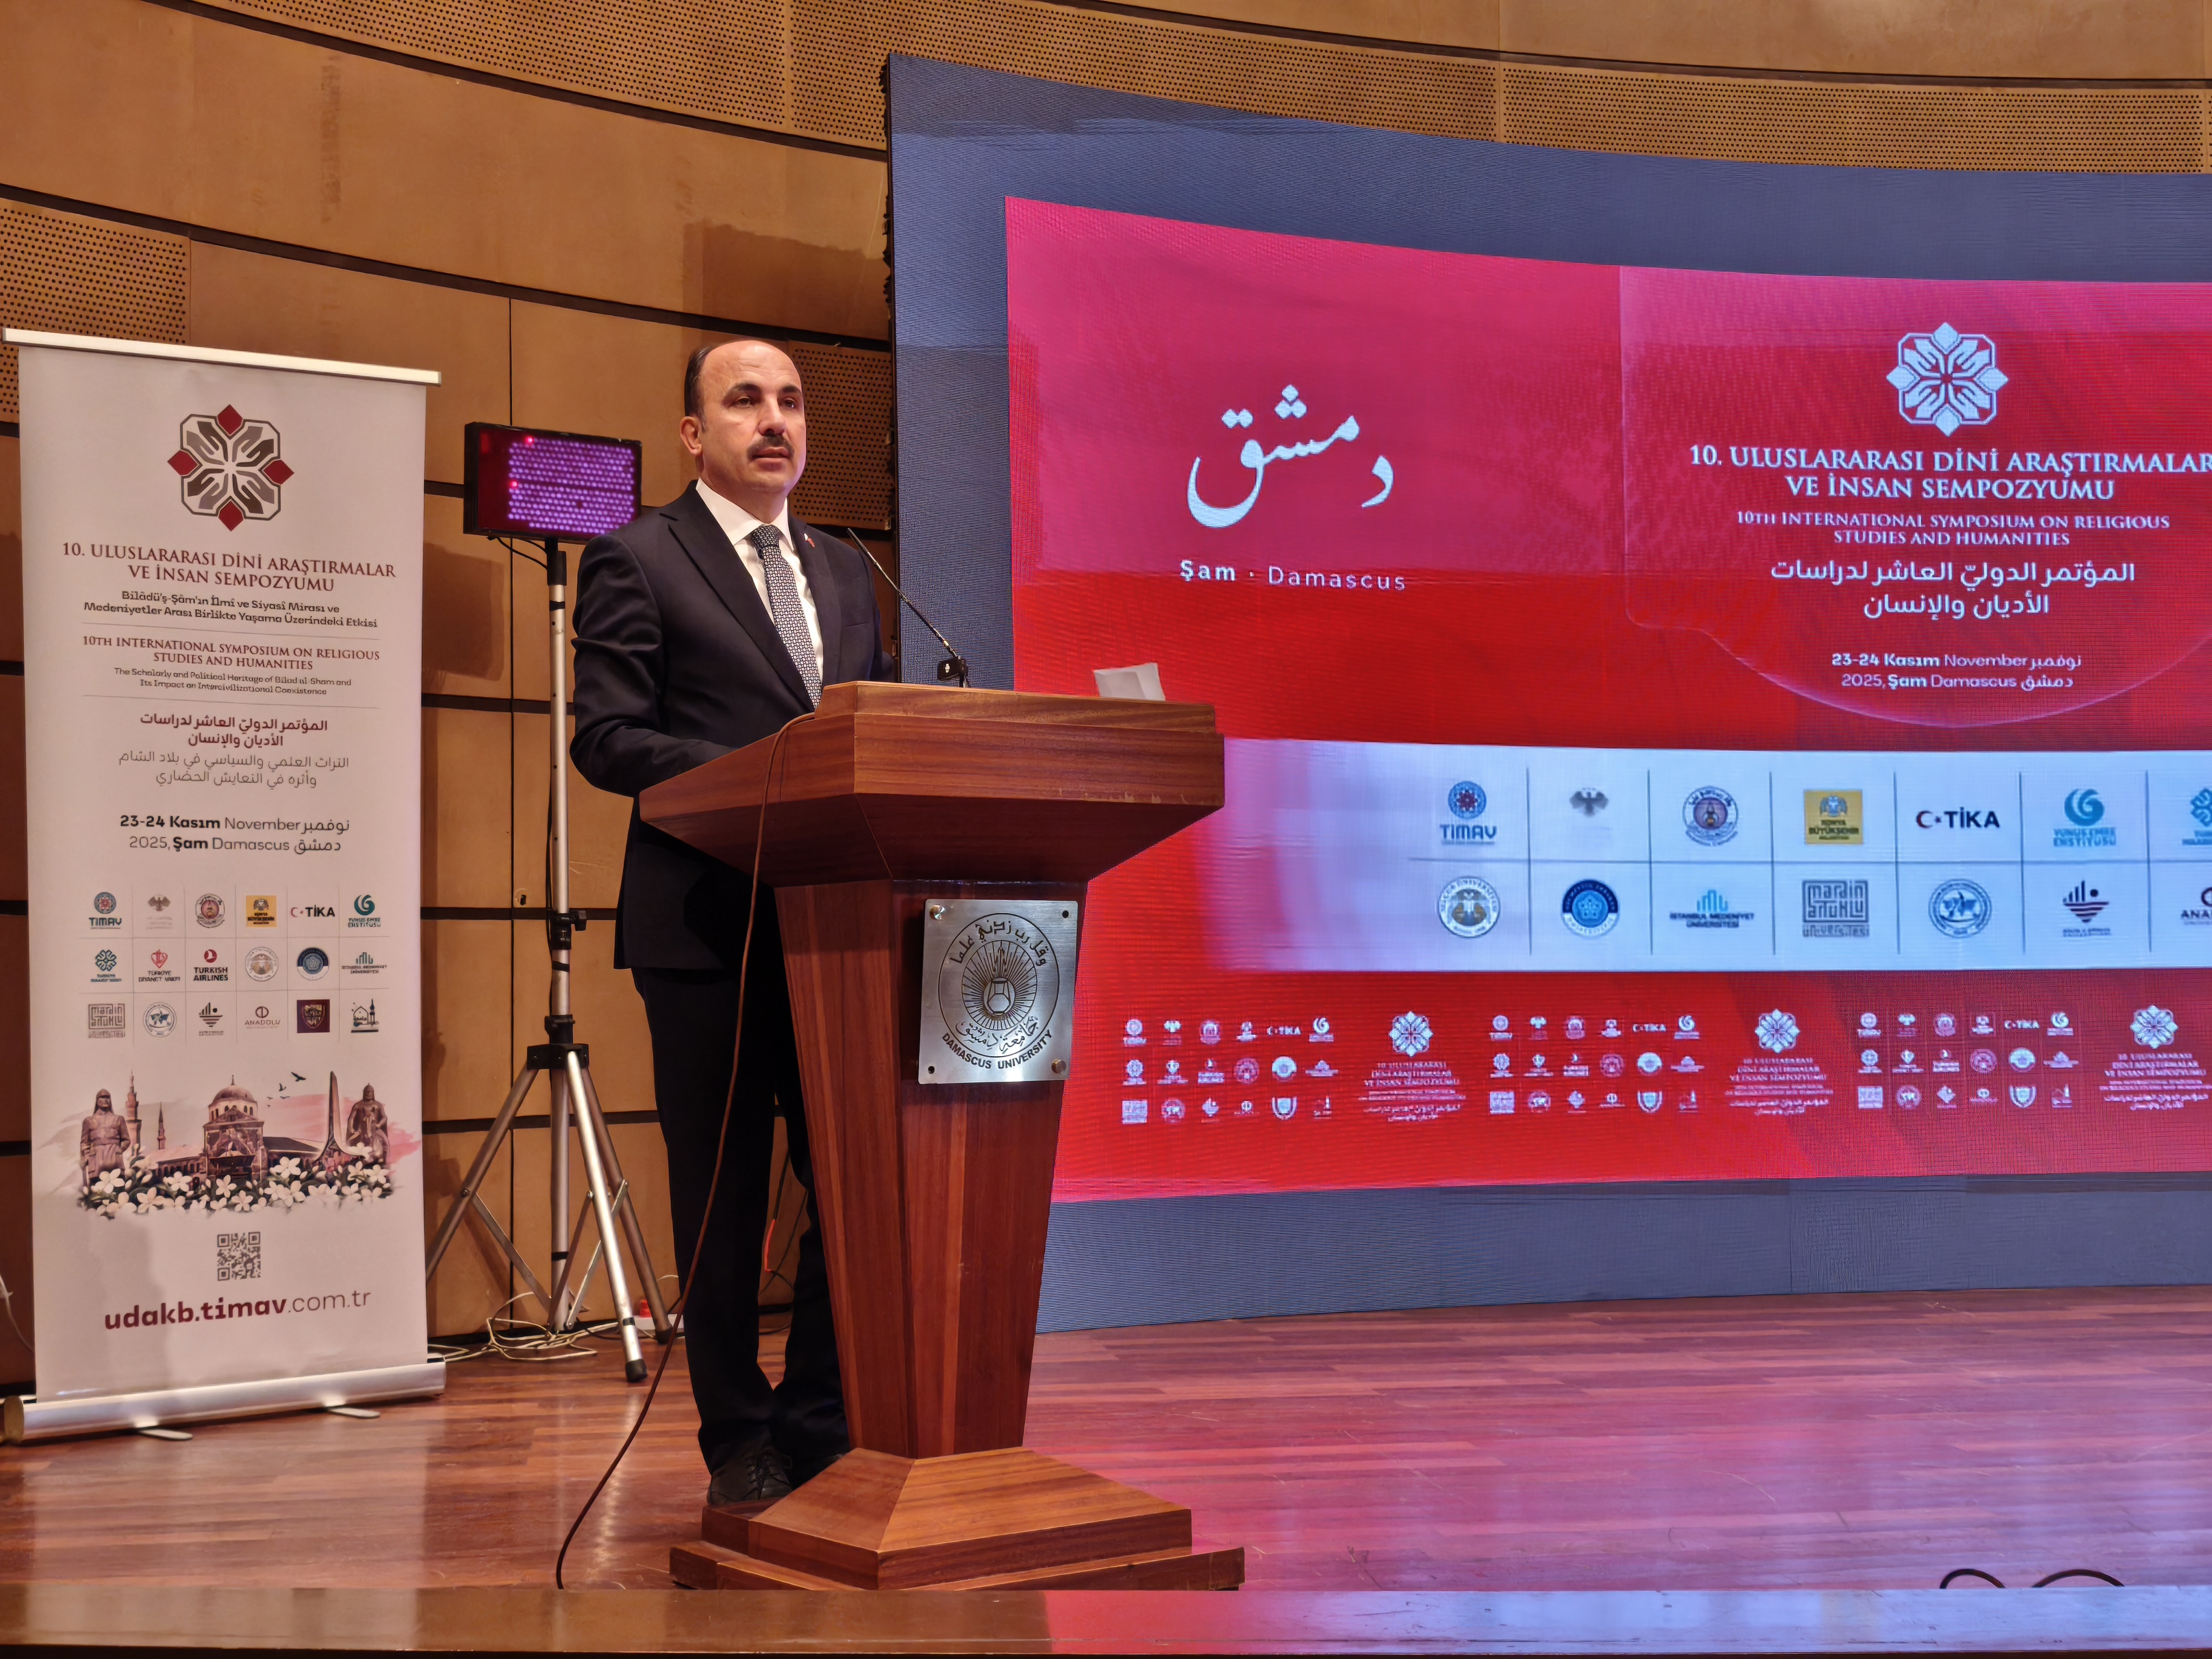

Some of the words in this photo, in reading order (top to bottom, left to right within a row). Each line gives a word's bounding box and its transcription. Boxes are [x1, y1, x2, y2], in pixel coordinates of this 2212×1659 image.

[1187, 384, 1394, 529] دمشق
[1689, 446, 1723, 466] 10.
[1730, 447, 1923, 471] ULUSLARARASI
[1933, 448, 1999, 473] DİNİ
[2006, 451, 2212, 478] ARAŞTIRMALAR
[1786, 476, 1820, 497] VE
[1827, 475, 1913, 498] İNSAN
[1922, 478, 2115, 500] SEMPOZYUMU
[1737, 511, 1775, 525] 10TH
[1782, 512, 1926, 528] INTERNATIONAL
[1930, 514, 2035, 529] SYMPOSIUM
[2040, 515, 2068, 529] ON
[2075, 515, 2170, 529] RELIGIOUS
[1834, 530, 1907, 544] STUDIES
[1911, 531, 1951, 545] AND
[1956, 531, 2071, 546] HUMANITIES
[62, 542, 85, 557] 10.
[91, 544, 216, 567] ULUSLARARASI
[222, 551, 262, 570] DİNİ
[267, 557, 396, 578] ARAŞTIRMALAR
[127, 564, 151, 580] VE
[156, 565, 209, 584] İNSAN
[214, 571, 335, 592] SEMPOZYUMU
[1181, 560, 1236, 582] Şam
[1268, 566, 1406, 591] Damascus
[1772, 560, 1868, 586] لدراسات
[1873, 559, 1952, 586] العاشر
[2042, 562, 2135, 588] المؤتمر
[288, 602, 325, 612] Mirası
[1864, 594, 1965, 620] والإنسان
[1973, 591, 2049, 619] الأديان
[84, 602, 162, 616] Medeniyetler
[164, 606, 192, 617] Arası
[195, 609, 236, 621] Birlikte
[239, 612, 282, 624] Yaşama
[285, 612, 344, 626] Üzerindeki
[346, 617, 377, 628] Etkisi
[83, 636, 112, 646] 10TH
[116, 637, 217, 653] INTERNATIONAL
[219, 643, 290, 657] SYMPOSIUM
[293, 647, 313, 658] ON
[317, 649, 380, 660] RELIGIOUS
[153, 652, 203, 664] STUDIES
[206, 655, 233, 666] AND
[237, 657, 313, 670] HUMANITIES
[1831, 653, 1879, 666] 23-24
[1884, 653, 1940, 667] Kasım
[1945, 654, 2028, 667] November
[2028, 655, 2082, 671] نوفمبر
[132, 668, 172, 679] Scholarly
[191, 671, 226, 681] Political
[1842, 675, 1885, 689] 2025,
[1887, 674, 1927, 690] Şam
[1931, 675, 2017, 687] Damascus
[2021, 675, 2074, 691] دمشق
[154, 679, 185, 689] Impact
[140, 713, 192, 728] لدراسات
[193, 714, 235, 729] العاشر
[278, 718, 327, 733] المؤتمر
[188, 732, 240, 748] والإنسان
[244, 733, 283, 748] الأديان
[119, 750, 155, 765] الشام
[159, 752, 179, 765] بلاد
[184, 753, 200, 769] في
[205, 754, 264, 770] والسياسي
[268, 756, 311, 772] العلمي
[315, 757, 349, 771] التراث
[156, 770, 209, 786] الحضاري
[213, 772, 262, 786] التعايش
[267, 774, 284, 790] في
[288, 770, 316, 788] وأثره
[120, 815, 166, 829] 23-24
[170, 815, 220, 830] Kasım
[225, 817, 300, 831] November
[301, 819, 350, 834] نوفمبر
[1944, 806, 2000, 828] TİKA
[1440, 824, 1497, 839] TIMAV
[130, 835, 171, 852] 2025,
[173, 837, 208, 853] Şam
[212, 837, 289, 851] Damascus
[294, 838, 341, 855] دمشق
[305, 905, 335, 917] TİKA
[89, 917, 122, 926] TIMAV
[942, 1032, 992, 1069] DAMASCUS
[997, 1029, 1053, 1069] UNIVERSITY
[104, 1289, 372, 1330] udakb.timav.com.tr
